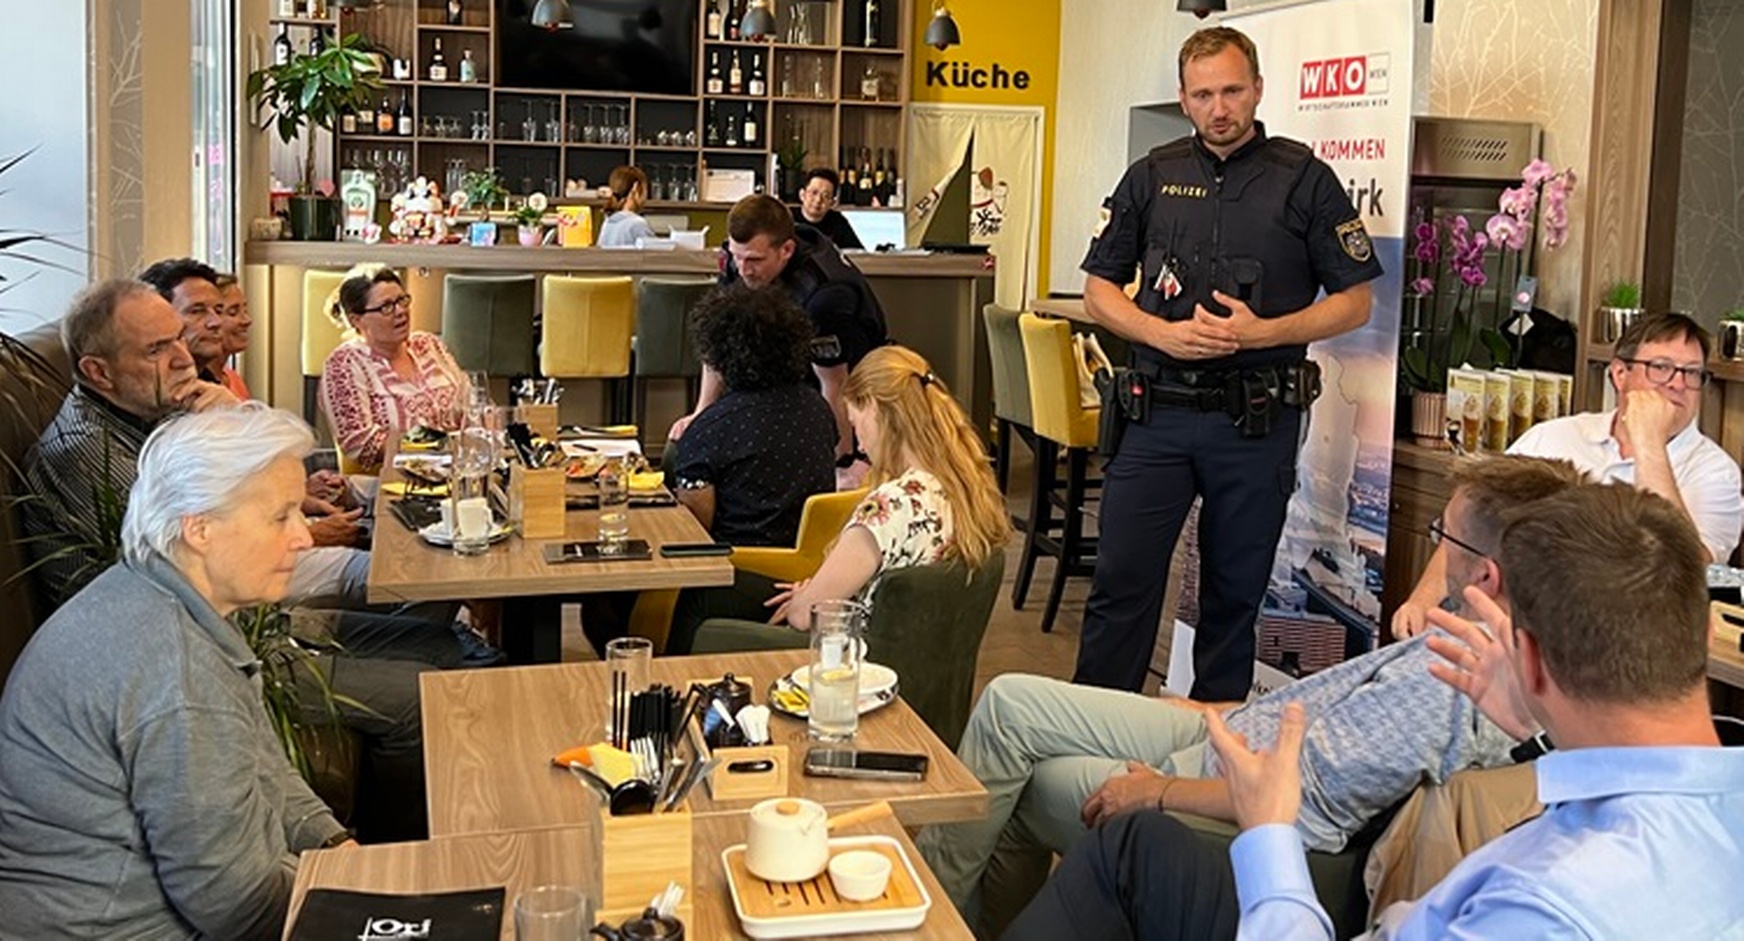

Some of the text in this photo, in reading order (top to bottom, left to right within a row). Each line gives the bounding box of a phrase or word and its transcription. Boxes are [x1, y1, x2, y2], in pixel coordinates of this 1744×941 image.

[926, 61, 1030, 90] Küche
[1303, 61, 1364, 94] WKO
[1161, 184, 1208, 198] POLIZEI
[1347, 178, 1384, 217] irk
